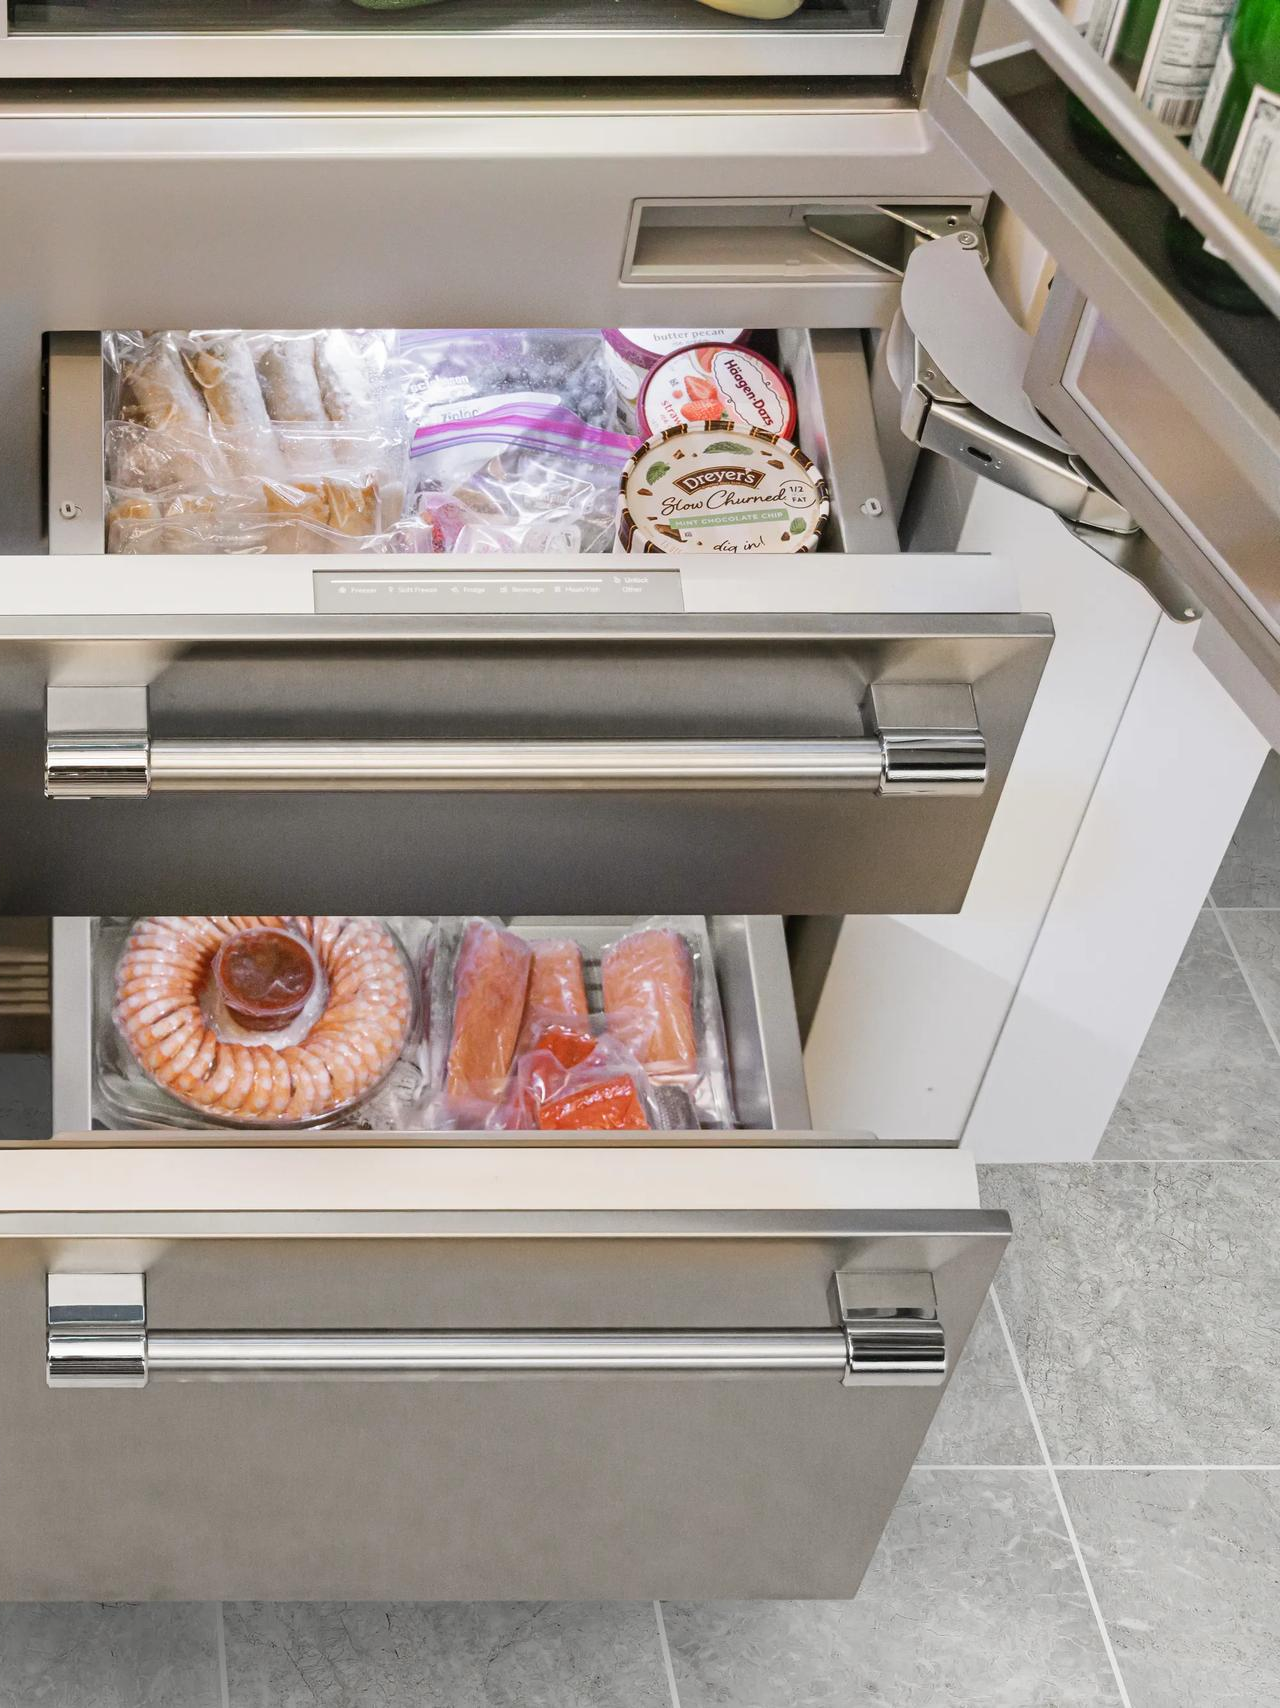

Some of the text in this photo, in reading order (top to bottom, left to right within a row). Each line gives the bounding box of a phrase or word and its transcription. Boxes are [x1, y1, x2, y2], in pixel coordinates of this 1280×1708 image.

[653, 328, 726, 341] butter pecan
[683, 469, 756, 490] Dreyer's
[661, 488, 787, 516] Slow Churned
[675, 511, 784, 527] MINT CHOCOLATE CHIP
[713, 540, 738, 554] dig
